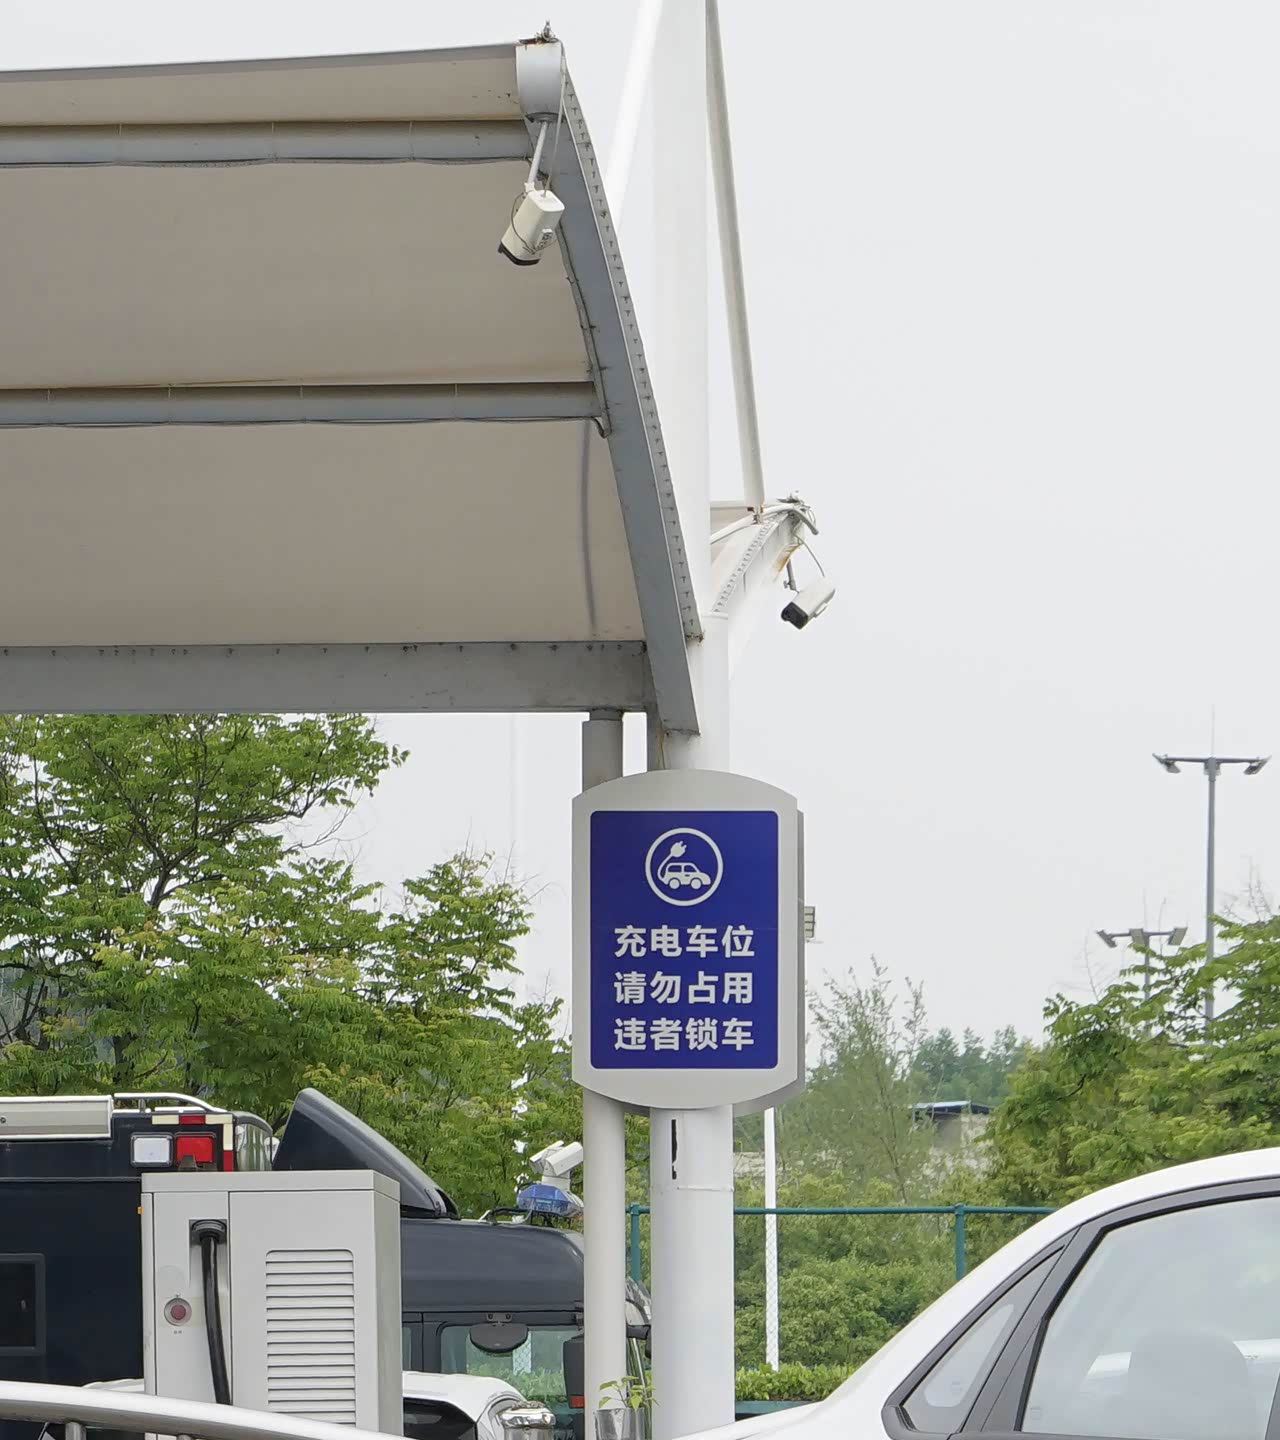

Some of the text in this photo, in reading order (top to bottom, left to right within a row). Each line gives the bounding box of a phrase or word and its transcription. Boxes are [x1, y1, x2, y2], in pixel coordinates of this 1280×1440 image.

[614, 924, 756, 958] 充电车位
[613, 971, 754, 1005] 请勿占用
[614, 1017, 755, 1051] 违者锁车
